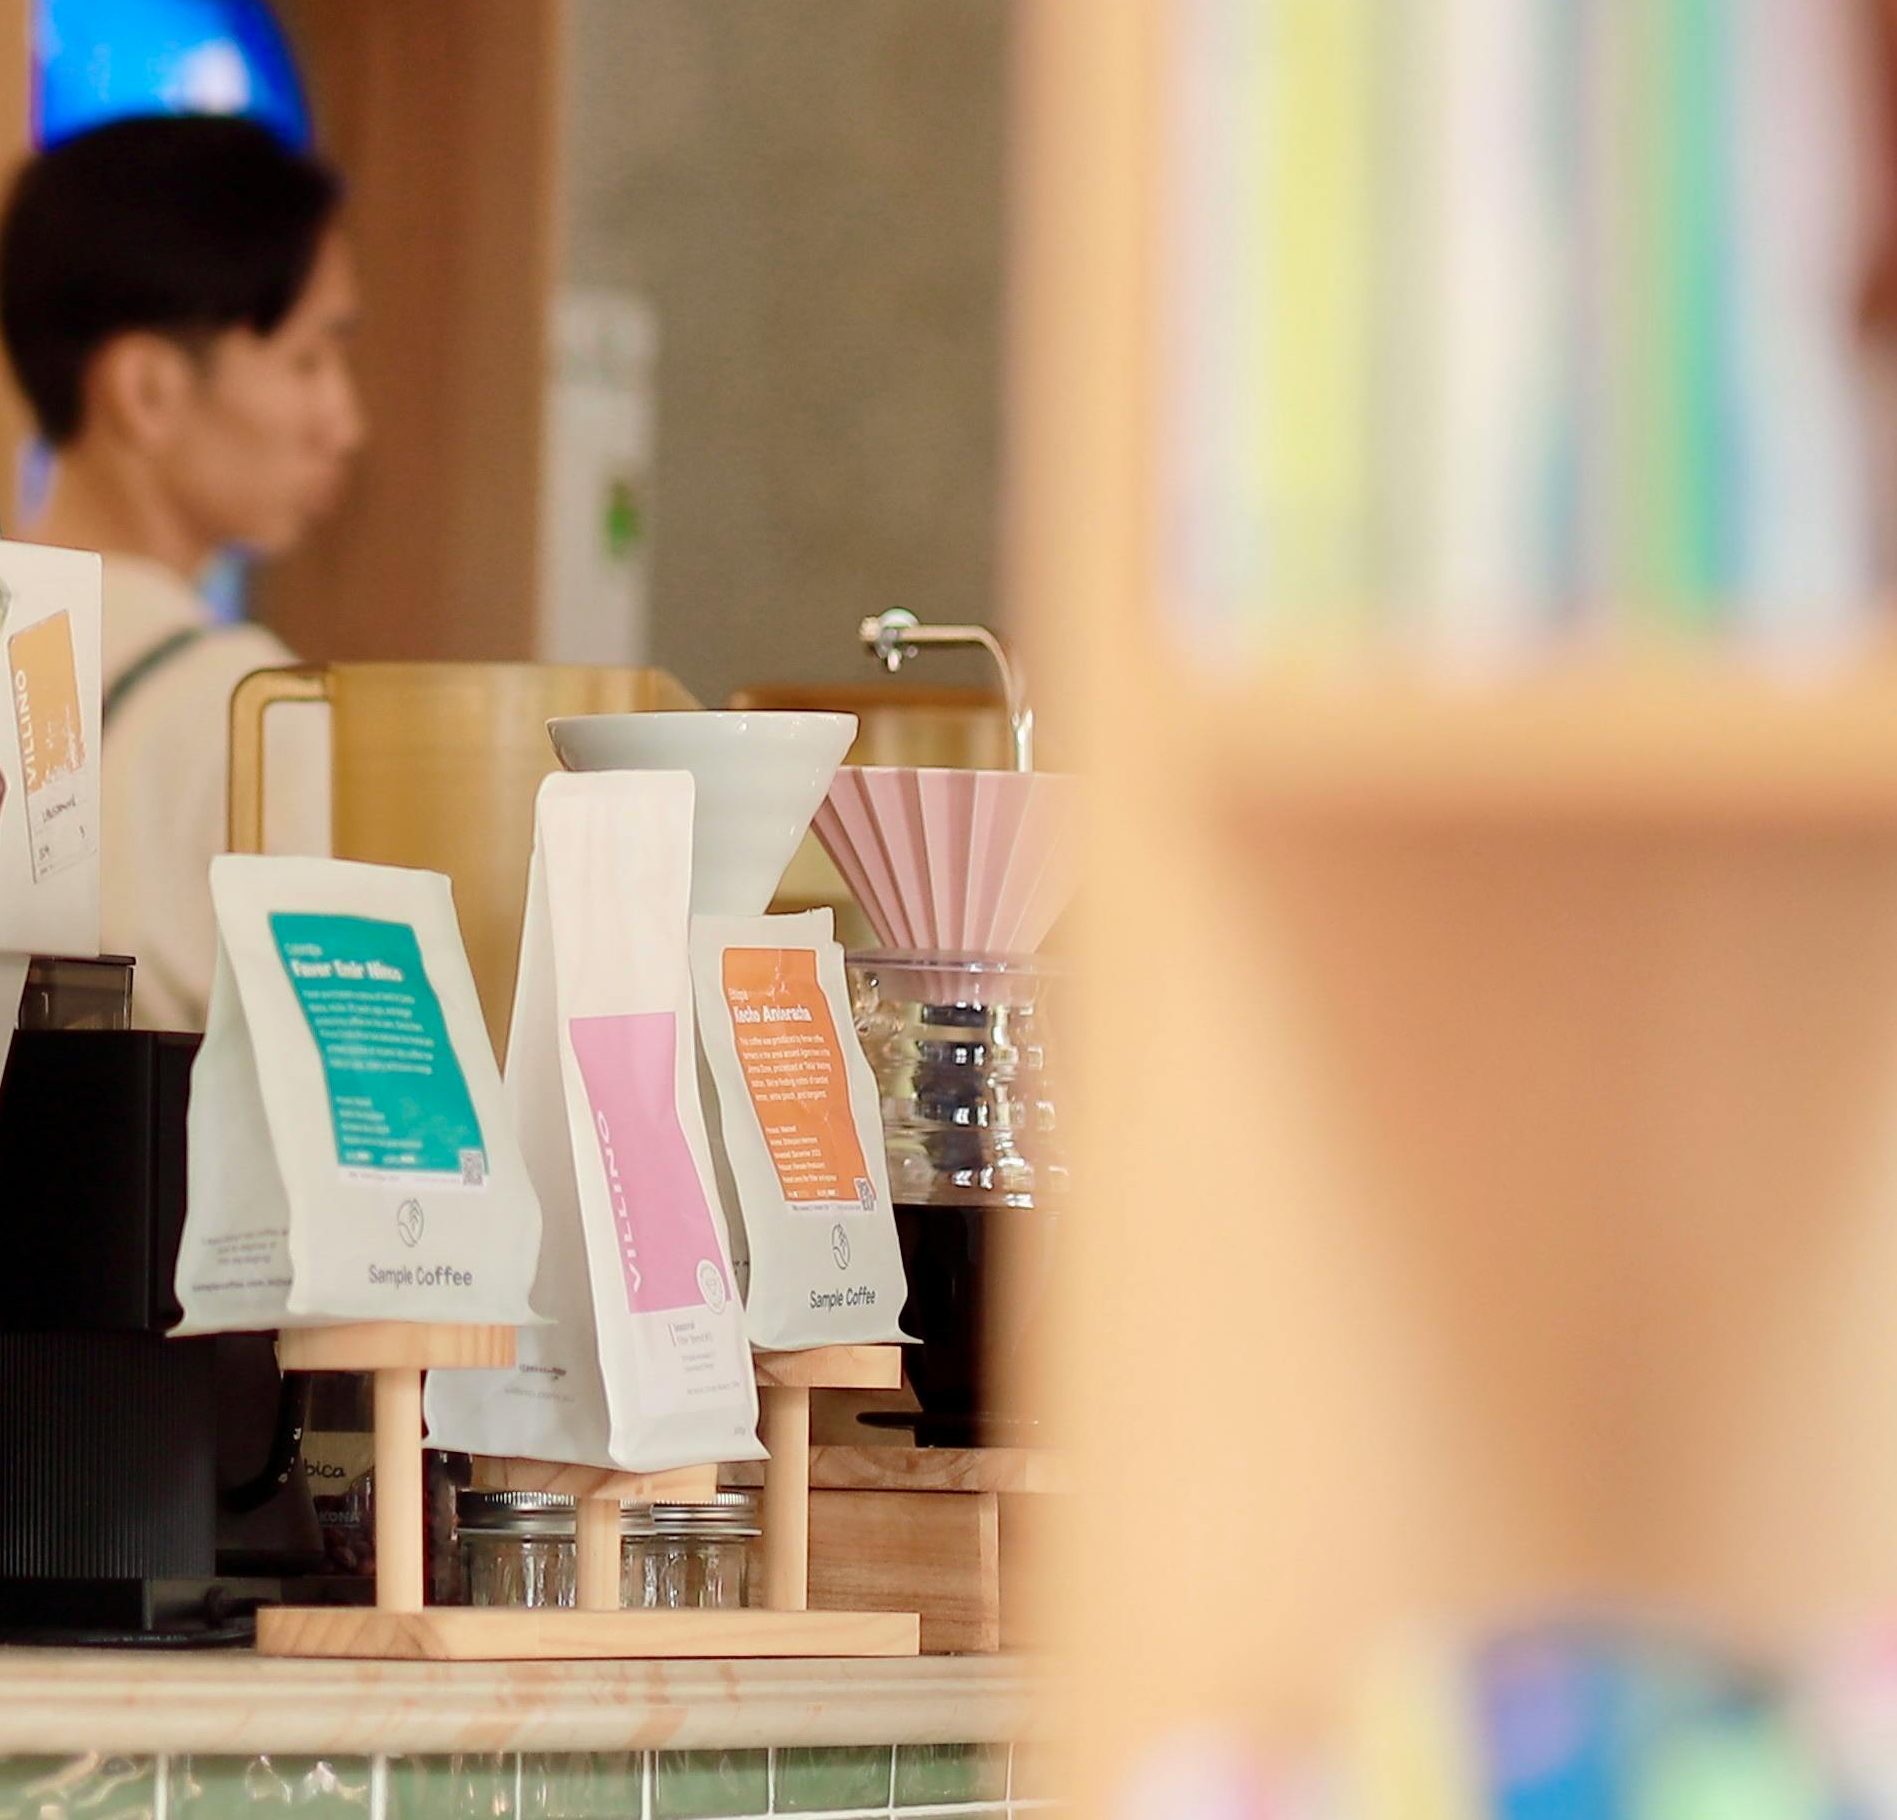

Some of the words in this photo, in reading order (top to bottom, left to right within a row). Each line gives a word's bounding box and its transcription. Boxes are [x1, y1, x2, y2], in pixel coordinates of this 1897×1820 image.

[15, 669, 37, 787] VILLINO
[598, 1110, 643, 1293] VILLINO
[369, 1263, 413, 1289] Sample
[416, 1265, 474, 1287] Coffee
[809, 1288, 844, 1313] Sample
[845, 1285, 876, 1307] Coffee
